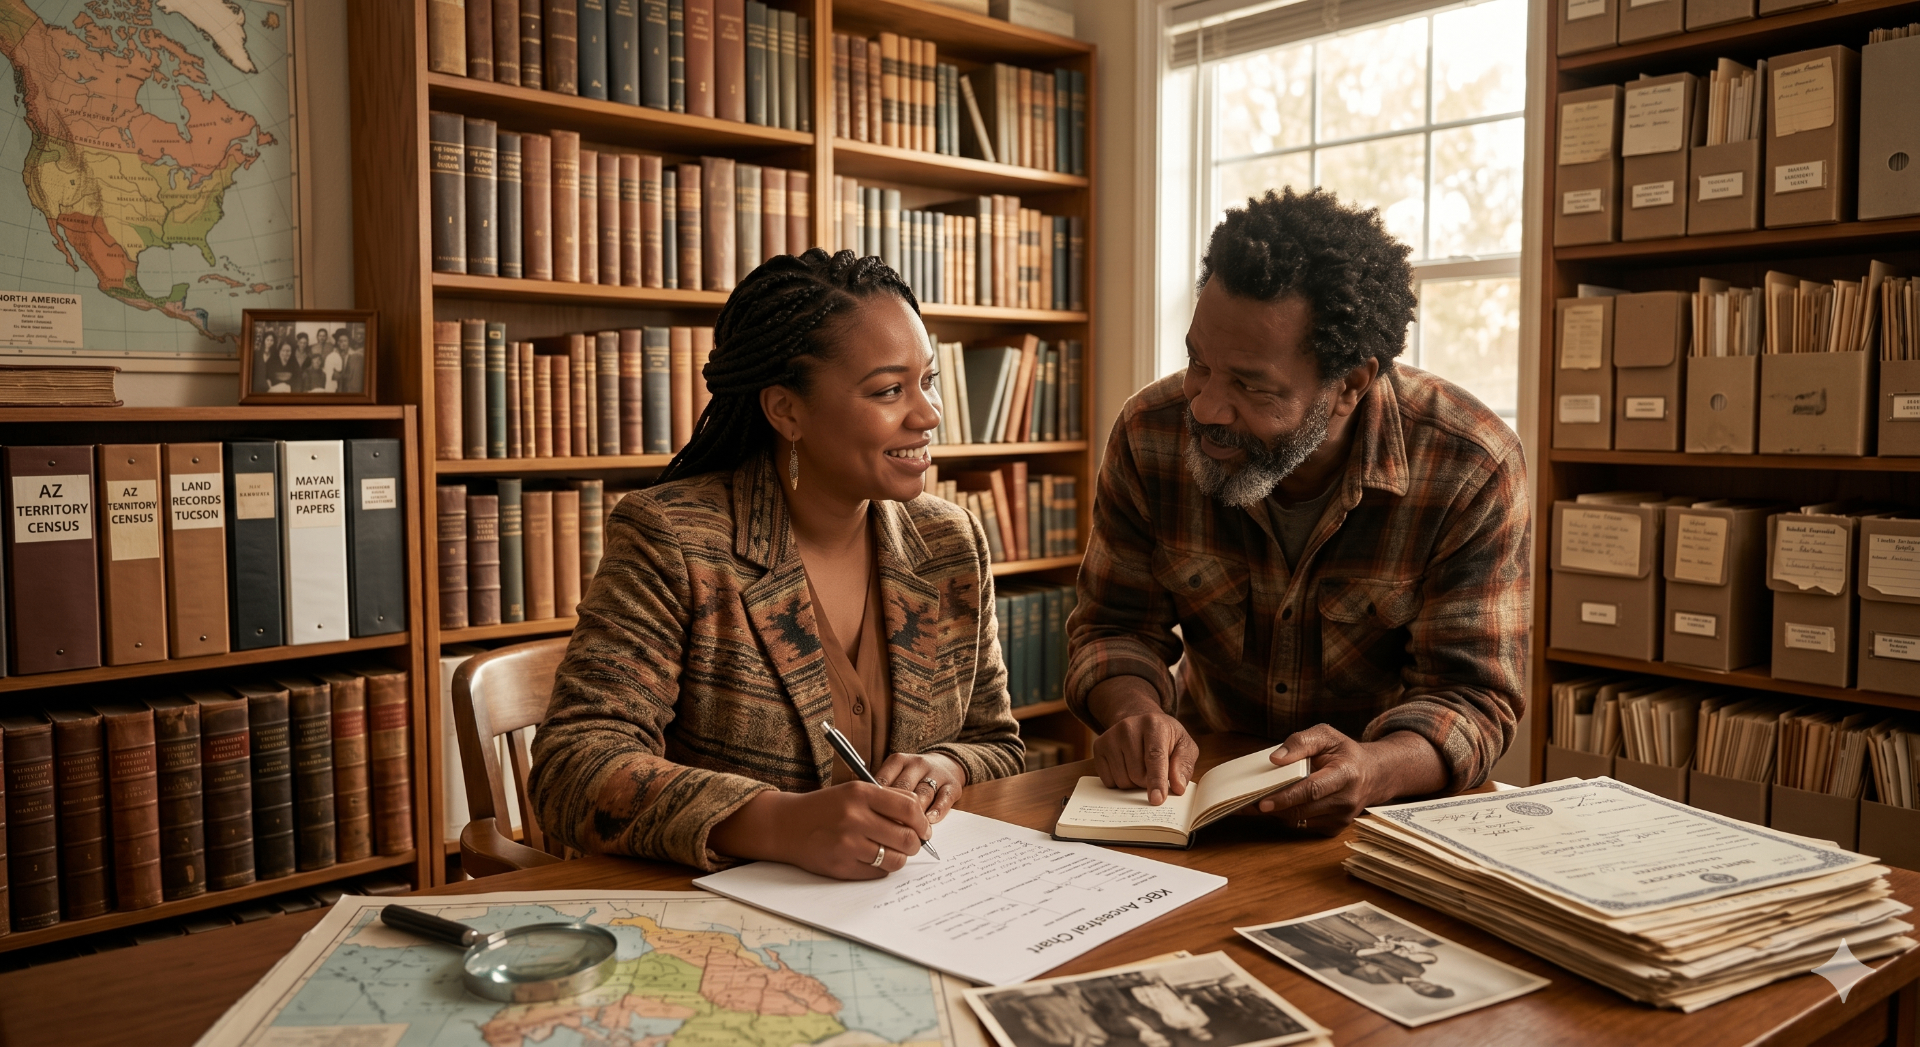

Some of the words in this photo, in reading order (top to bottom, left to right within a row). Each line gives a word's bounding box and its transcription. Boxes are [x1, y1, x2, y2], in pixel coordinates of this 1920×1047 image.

[31, 296, 77, 305] AMERICRA
[182, 481, 211, 491] LAND
[296, 476, 334, 486] MAYAN
[39, 484, 63, 498] AZ
[123, 487, 138, 497] AZ
[290, 489, 340, 500] HERITAGE
[172, 495, 221, 506] RECORDS
[16, 503, 88, 516] TERRITORY
[296, 504, 335, 514] PAPERS
[112, 513, 153, 524] CENSUS
[175, 510, 219, 520] TUCSON
[28, 520, 79, 533] CENSUS
[1137, 888, 1173, 904] KBC
[1071, 901, 1140, 935] Ancestral
[1026, 932, 1074, 954] Chart
